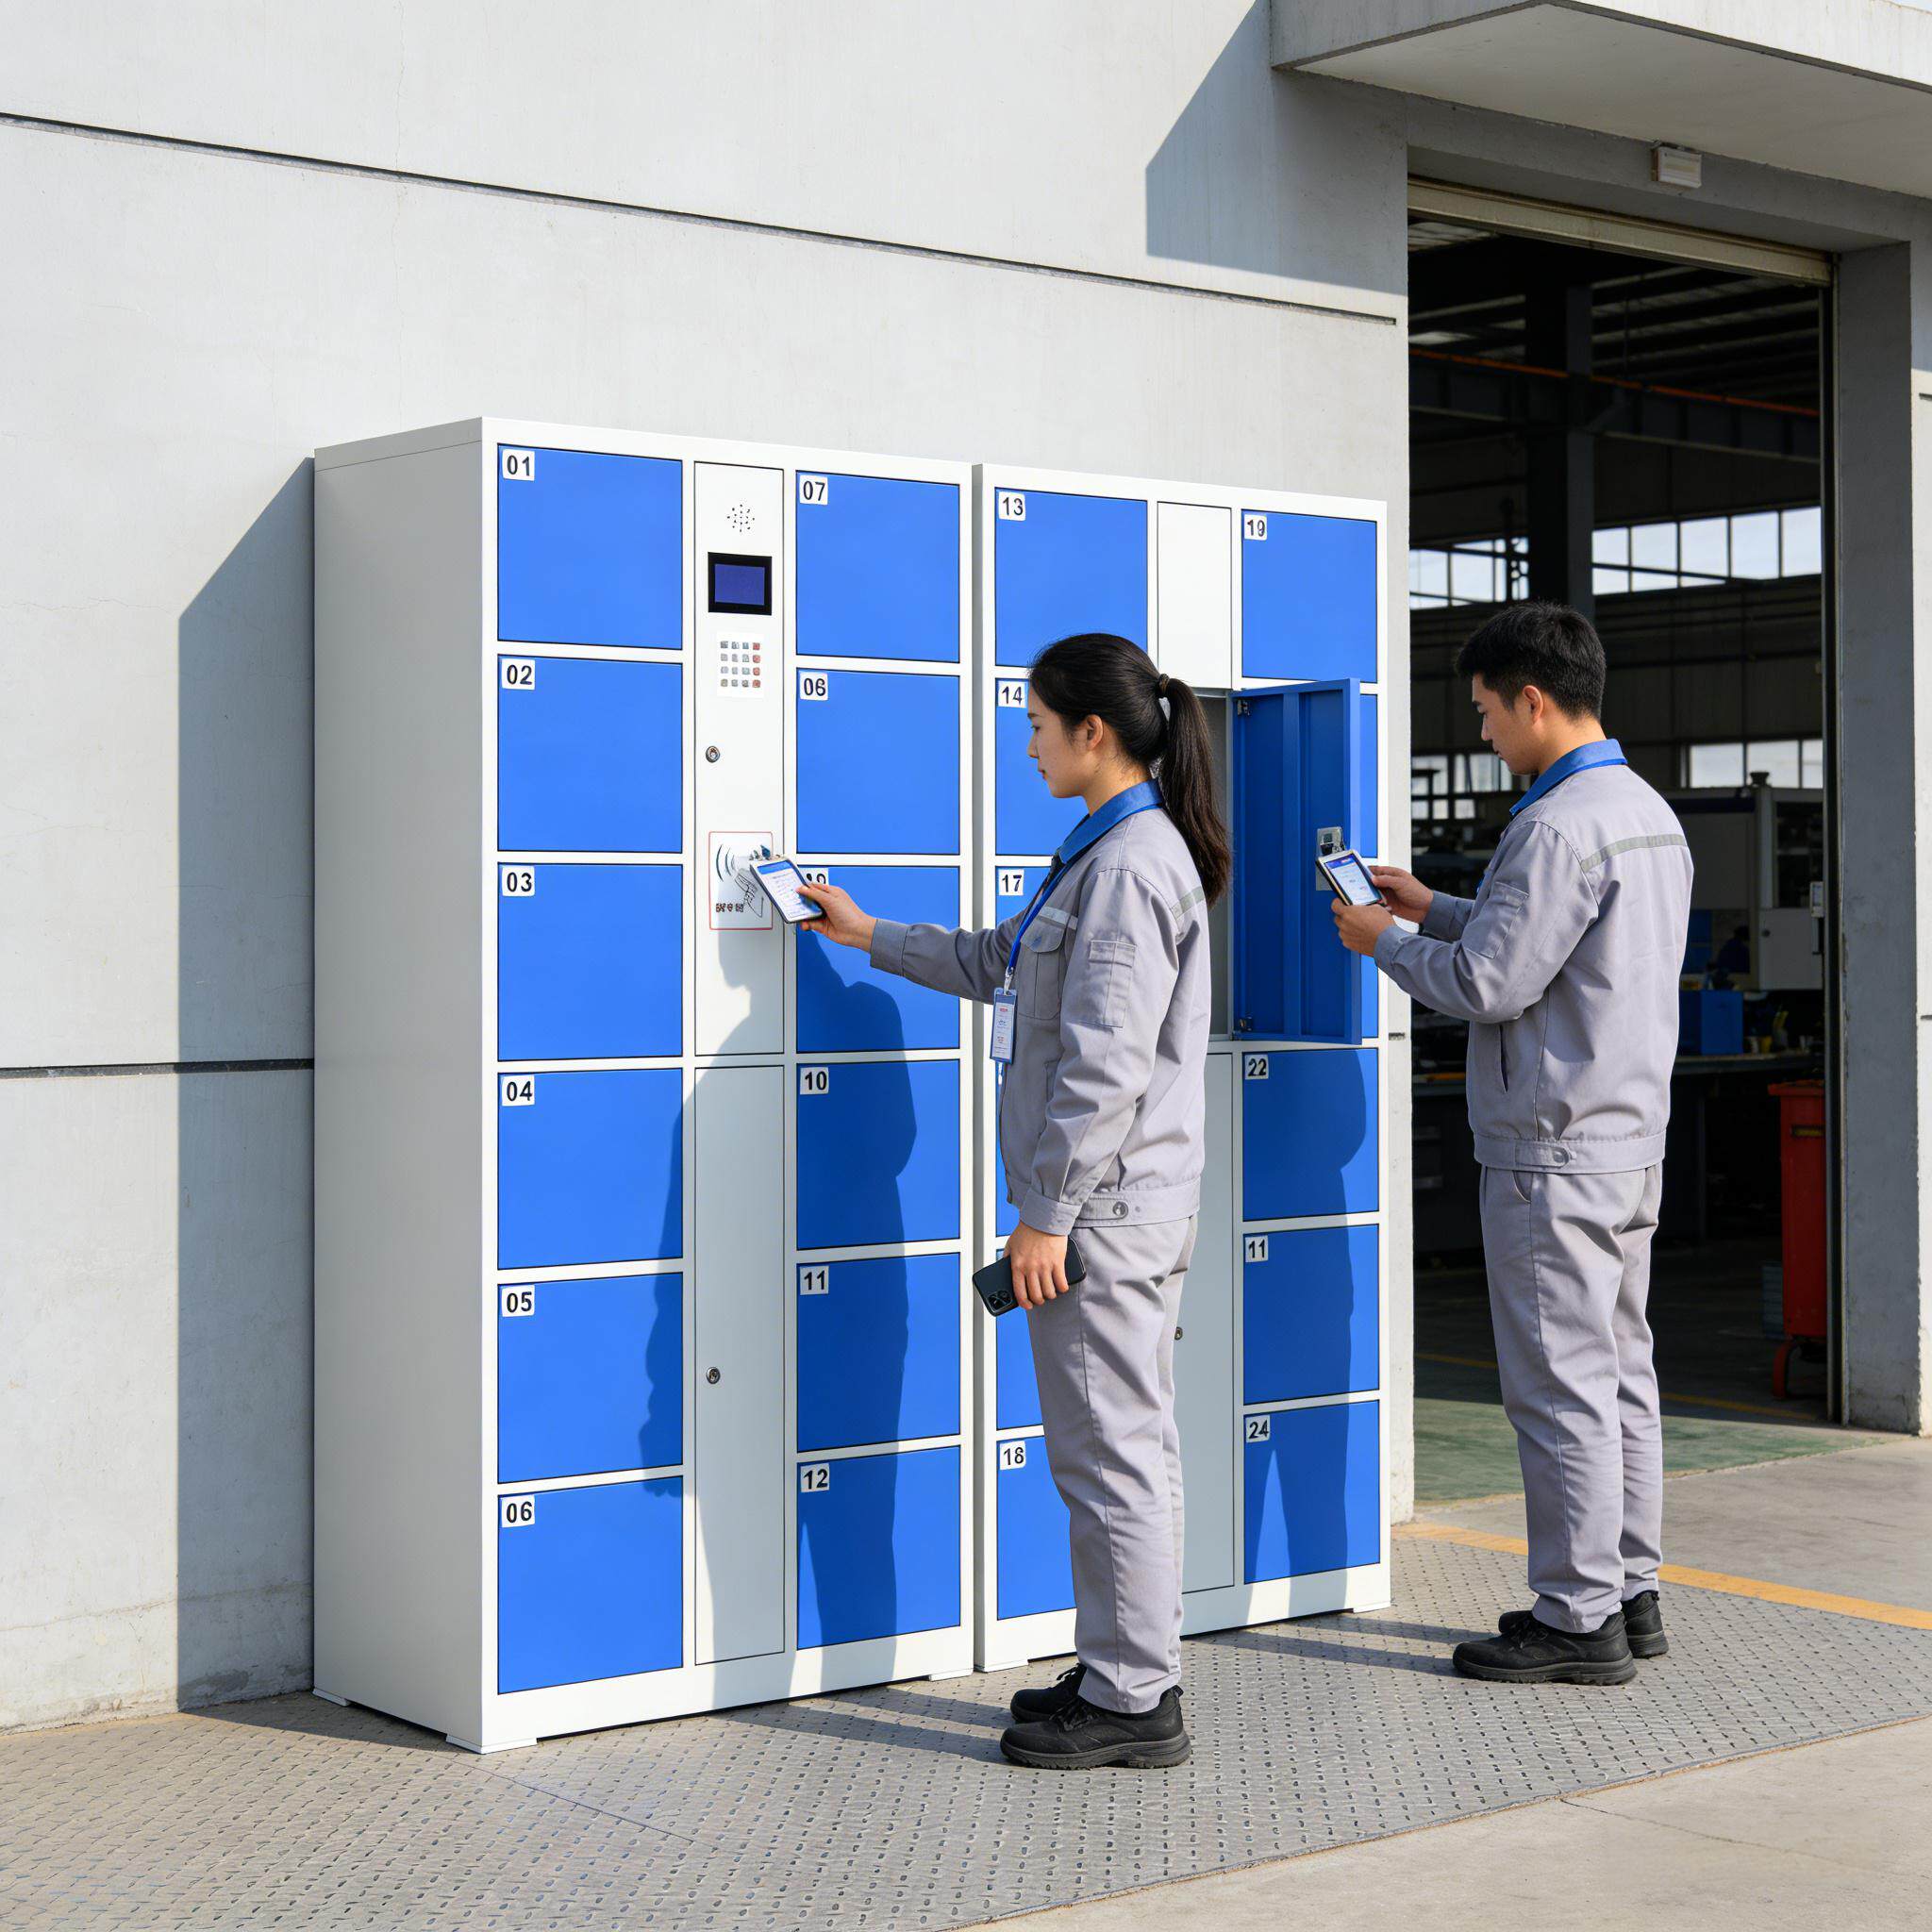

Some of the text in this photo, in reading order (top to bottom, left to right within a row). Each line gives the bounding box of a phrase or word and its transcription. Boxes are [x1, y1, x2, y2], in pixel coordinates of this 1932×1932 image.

[508, 455, 530, 476] 01
[803, 481, 825, 501] 07
[1003, 496, 1024, 516] 13
[1246, 519, 1266, 537] 19
[508, 664, 533, 685] 02
[1002, 686, 1024, 705] 14
[508, 872, 533, 892] 03
[1002, 874, 1023, 892] 17
[1247, 1058, 1267, 1076] 22
[804, 1071, 827, 1091] 10
[508, 1081, 533, 1102] 04
[1248, 1239, 1266, 1258] 11
[804, 1270, 825, 1291] 11
[508, 1291, 533, 1313] 05
[1248, 1419, 1270, 1440] 24
[803, 1468, 828, 1490] 12
[507, 1501, 533, 1524] 06
